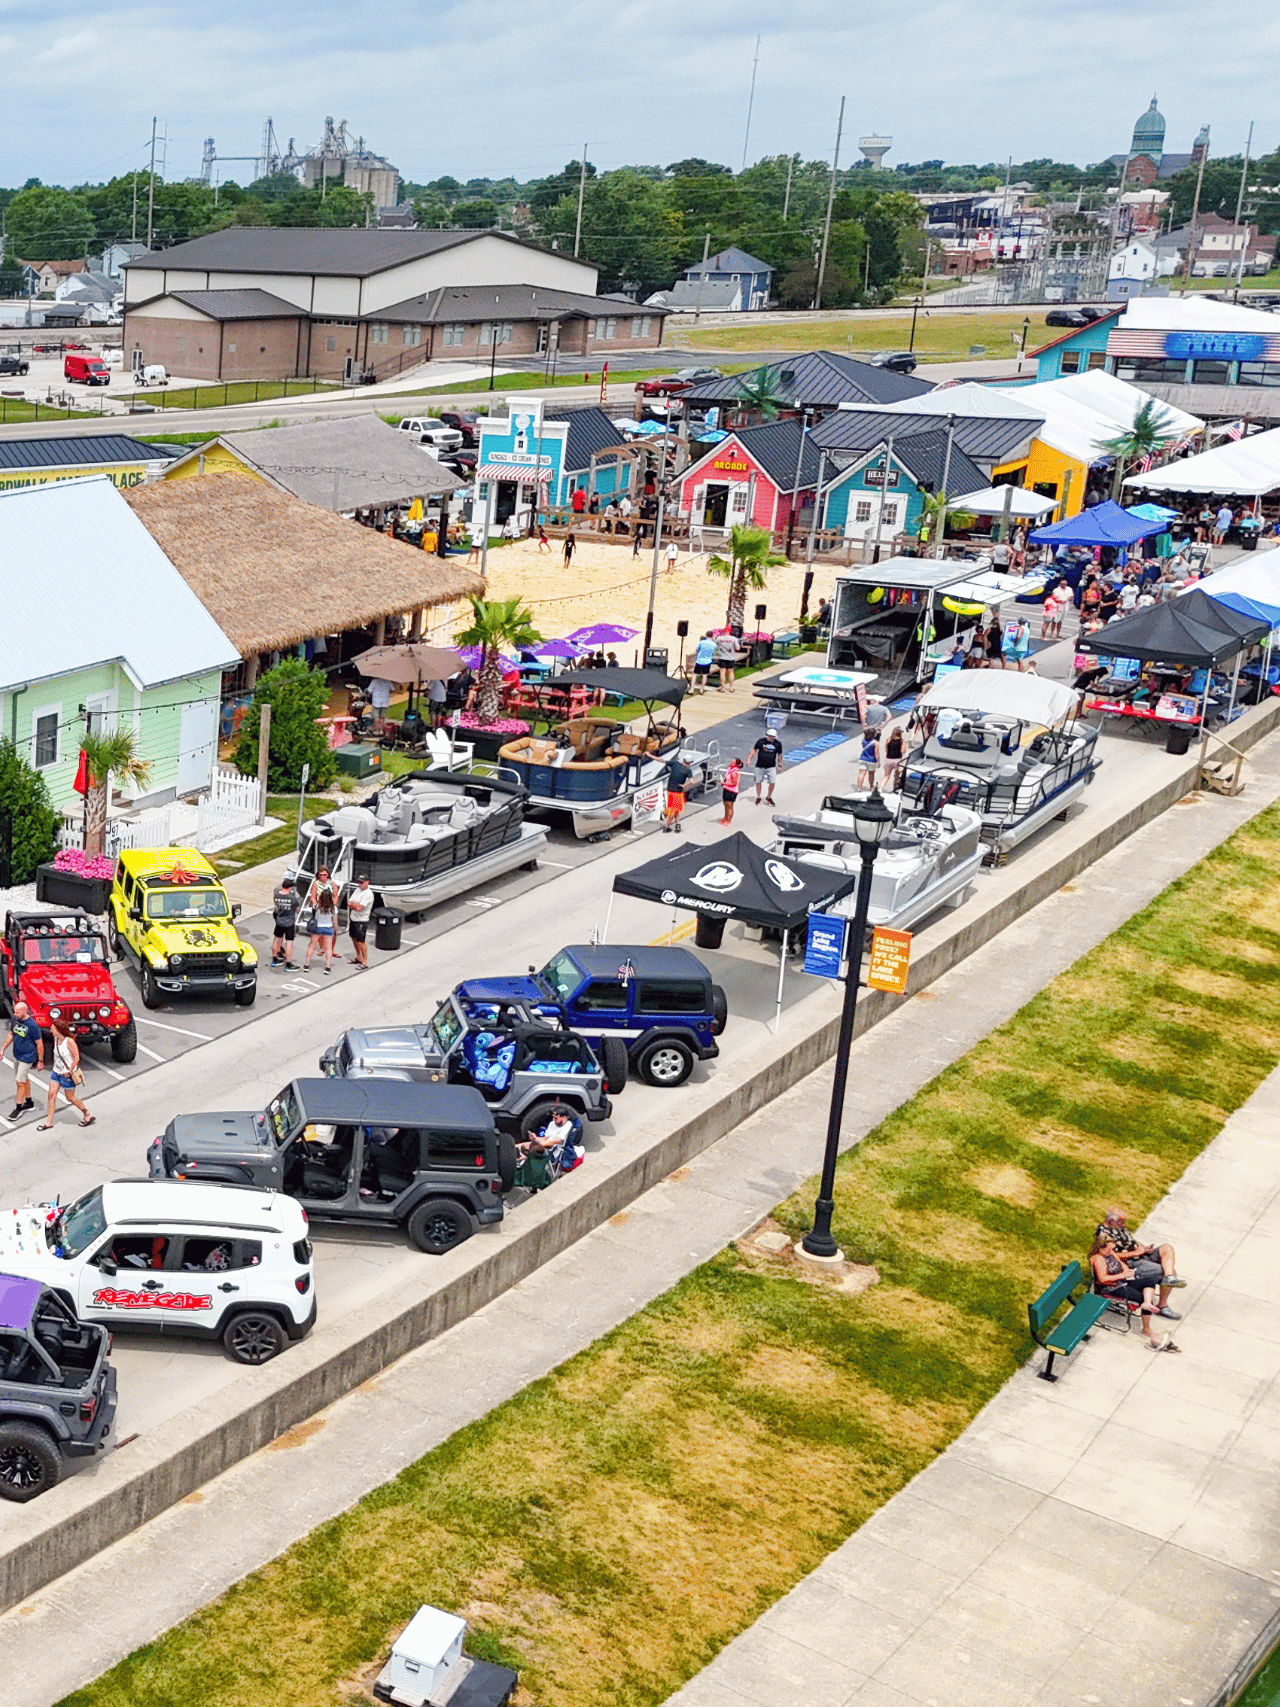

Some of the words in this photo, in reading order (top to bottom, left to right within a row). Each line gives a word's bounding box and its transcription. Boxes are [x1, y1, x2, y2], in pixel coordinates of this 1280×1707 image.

[713, 460, 747, 471] ARCADE
[677, 895, 737, 915] MERCURY
[812, 935, 830, 945] Lake
[813, 930, 835, 940] Grand
[811, 942, 838, 953] Region
[876, 937, 908, 948] FEELING
[874, 951, 887, 959] WE
[888, 953, 908, 963] CALL
[93, 1287, 213, 1311] RENEGADE
